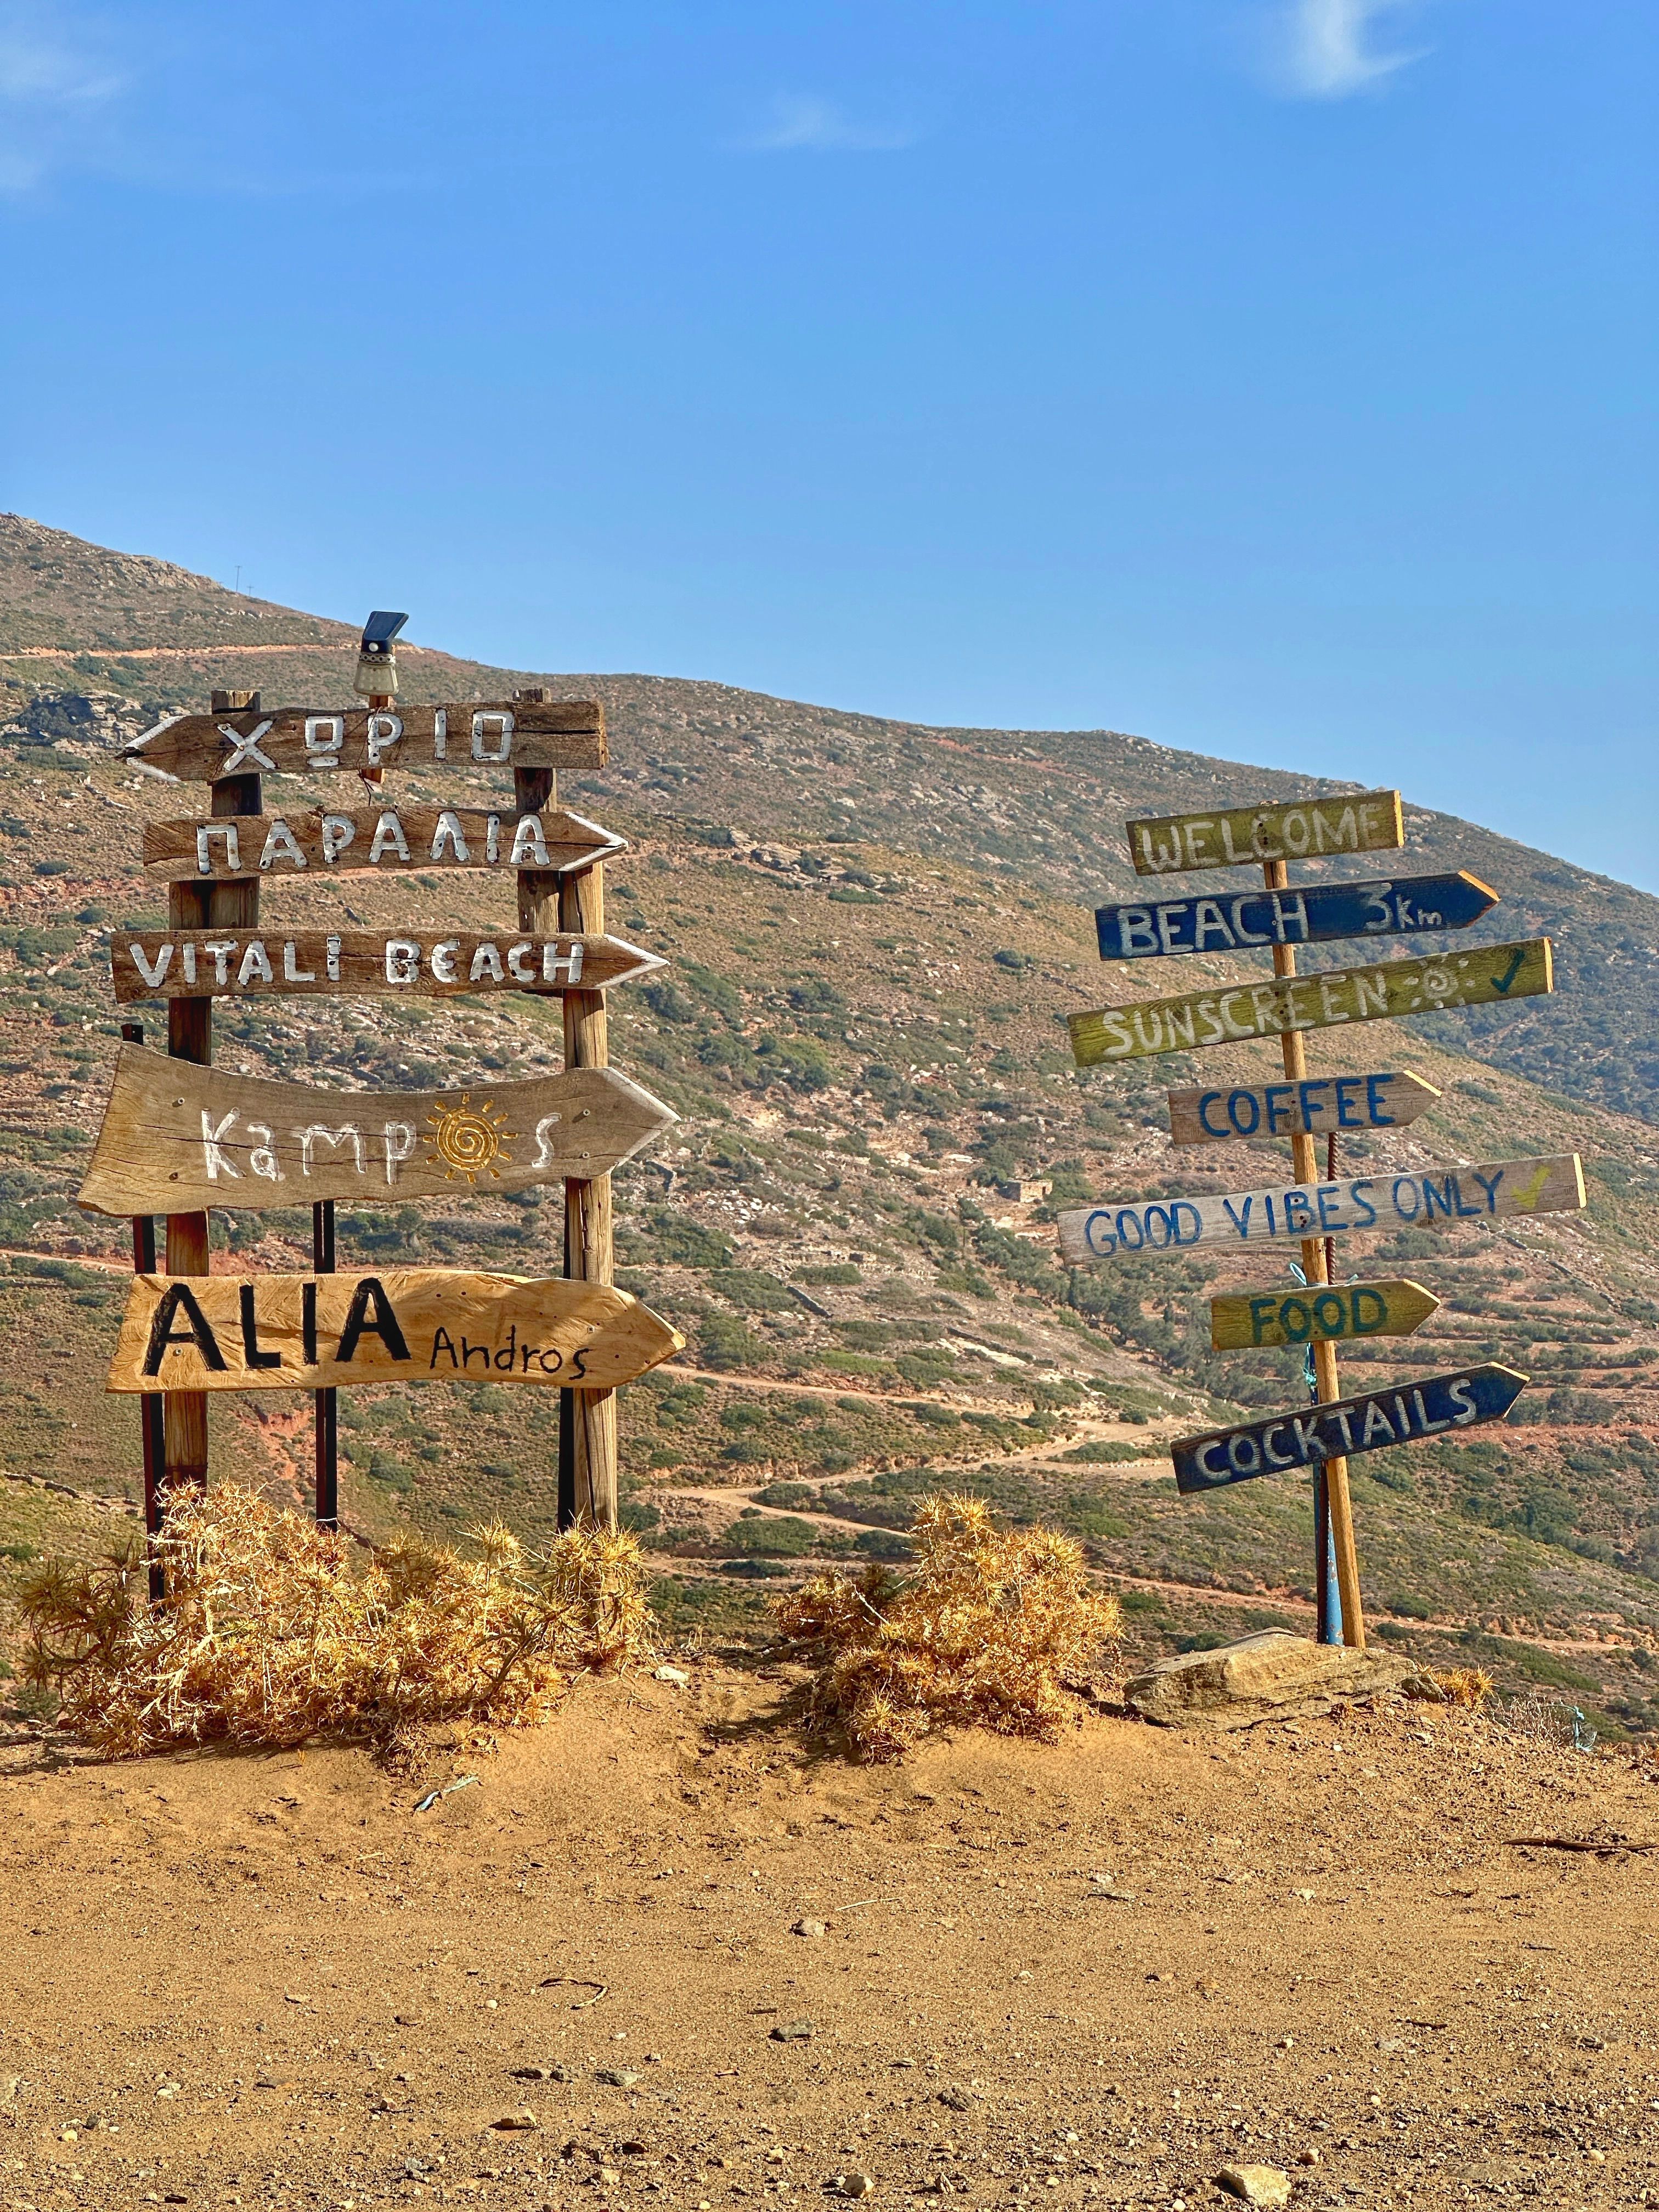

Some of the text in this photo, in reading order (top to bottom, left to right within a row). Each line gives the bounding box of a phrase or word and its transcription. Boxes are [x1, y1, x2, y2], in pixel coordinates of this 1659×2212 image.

[196, 811, 550, 873] ΠΑΡΑΛΙΑ
[1141, 803, 1391, 871] WELCOME
[1118, 891, 1310, 956] BEACH
[129, 935, 585, 988] VITALI BEACH
[1103, 972, 1389, 1056] SUNSCREEN
[1199, 1074, 1395, 1137] COFFEE
[1085, 1170, 1504, 1257] GOOD VIBES ONLY
[141, 1278, 591, 1380] ALIA Andros
[1250, 1288, 1388, 1345] FOOD
[1195, 1379, 1478, 1480] COCKTAILS
